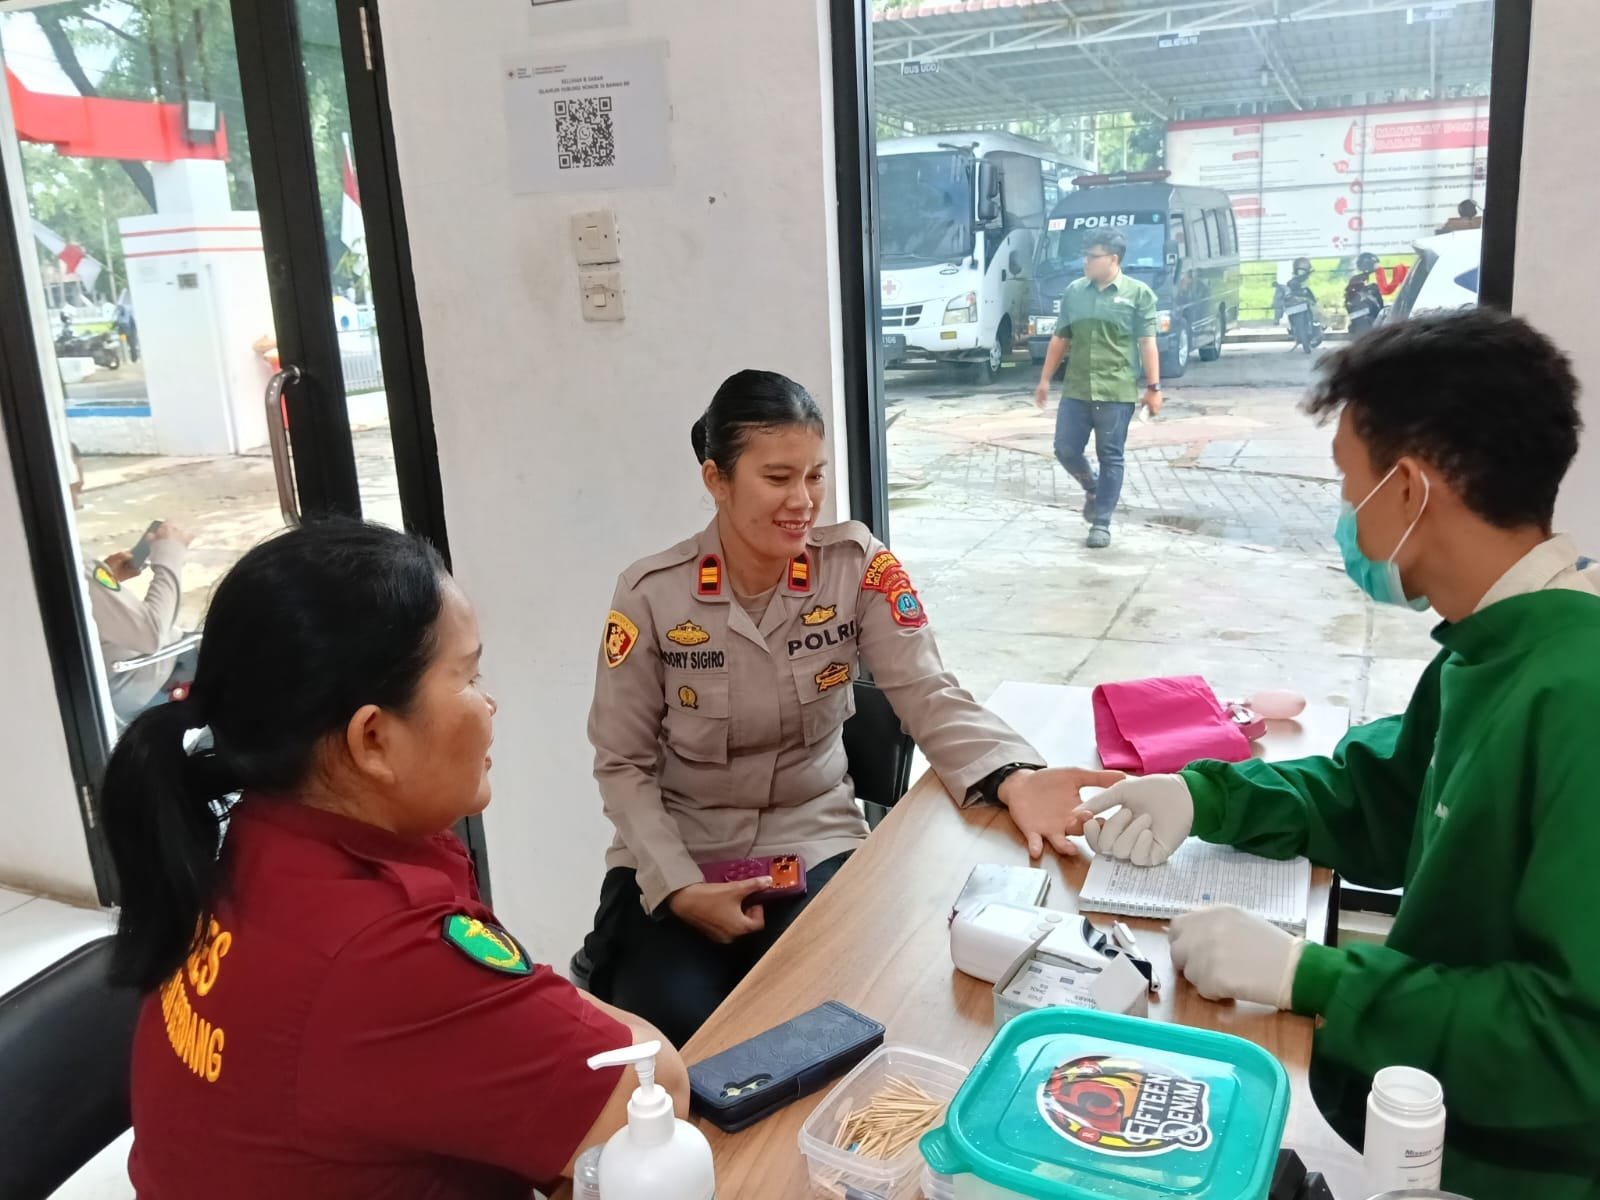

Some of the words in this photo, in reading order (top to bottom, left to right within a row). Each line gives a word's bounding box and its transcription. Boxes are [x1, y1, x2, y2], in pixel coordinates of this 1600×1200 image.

[1073, 214, 1135, 229] POLISI
[788, 620, 854, 656] POLRI
[691, 650, 725, 669] SIGIRO
[1124, 1072, 1172, 1143] FIFTEEN
